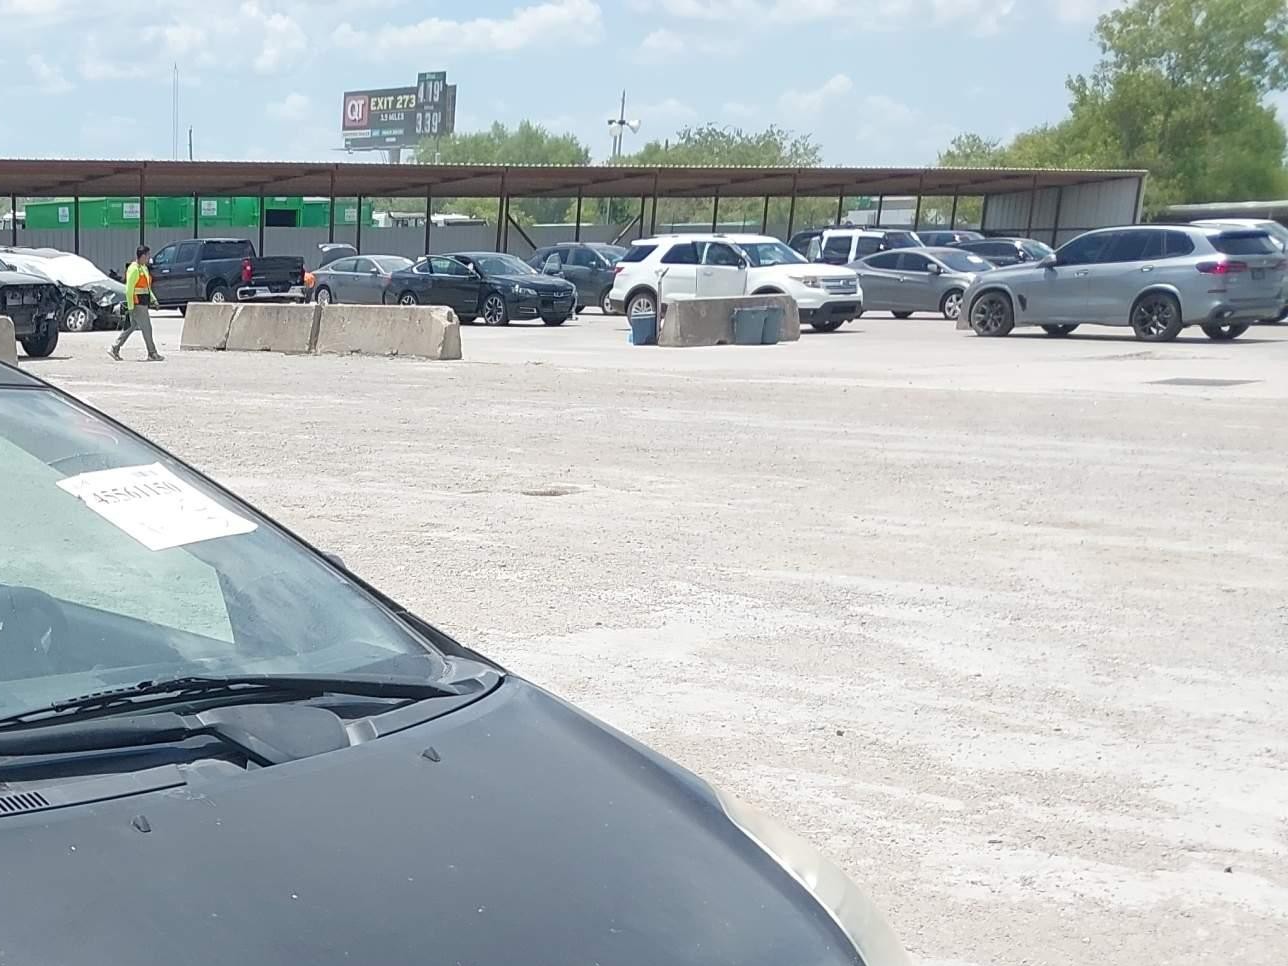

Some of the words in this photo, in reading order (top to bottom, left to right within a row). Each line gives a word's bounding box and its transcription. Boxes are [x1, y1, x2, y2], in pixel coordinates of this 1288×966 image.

[347, 99, 365, 121] QT
[370, 96, 394, 111] EXIT
[396, 94, 416, 109] 273
